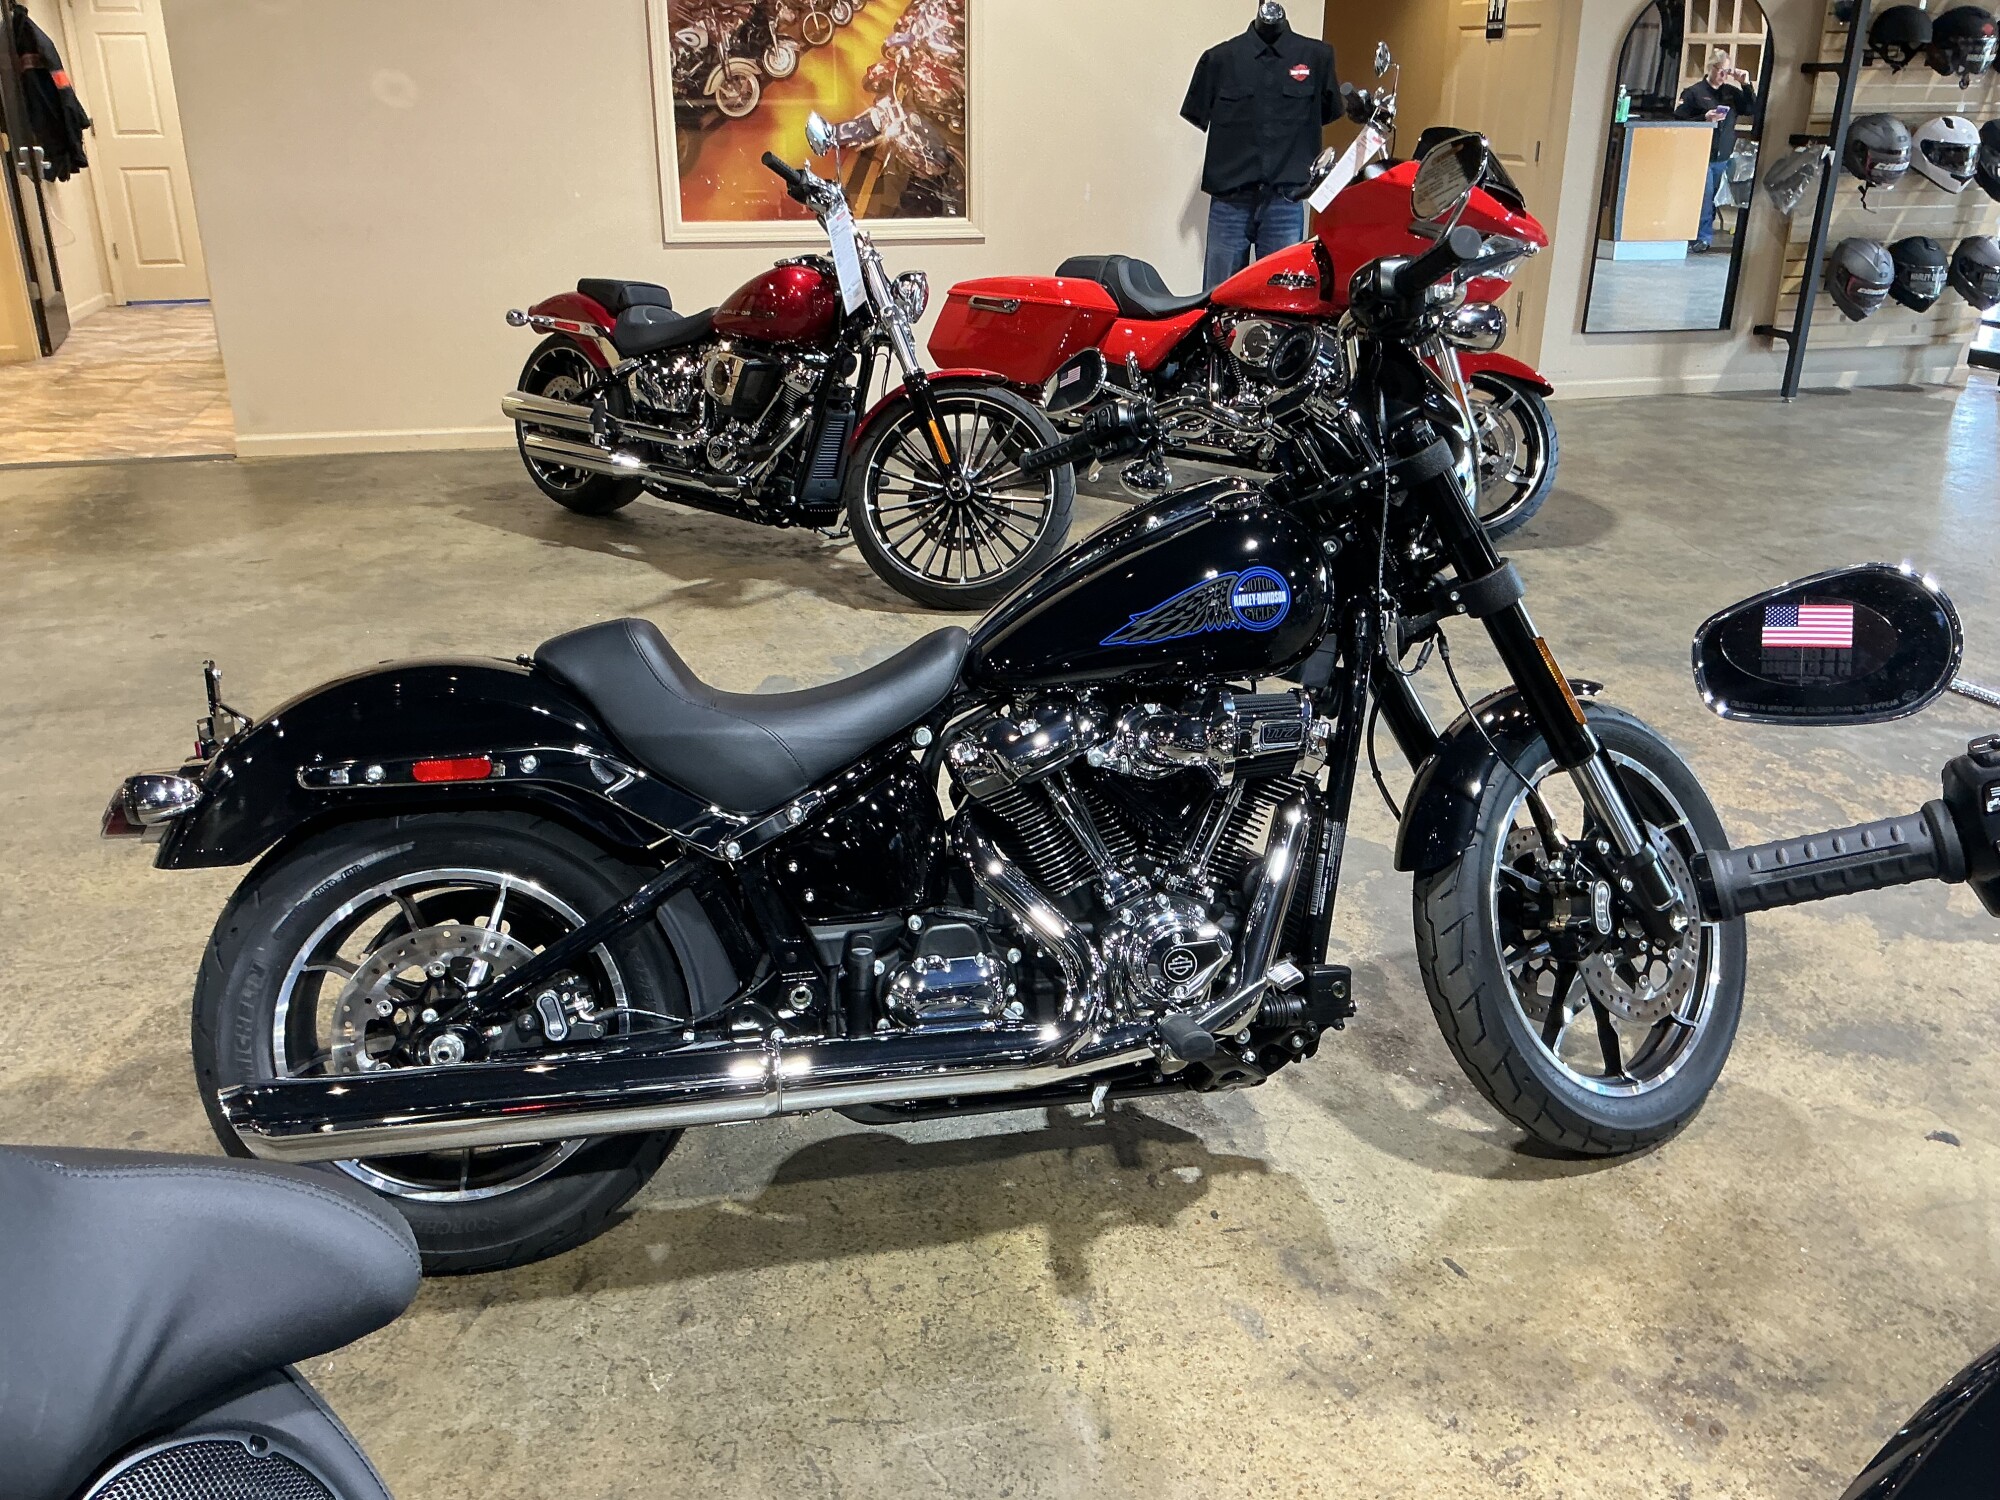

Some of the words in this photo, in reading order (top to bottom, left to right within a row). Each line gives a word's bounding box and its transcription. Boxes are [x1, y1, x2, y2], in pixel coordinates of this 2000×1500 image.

[1243, 576, 1275, 592] MOTOR
[1233, 590, 1287, 607] HARLEY-DAVIDSON
[1244, 605, 1277, 621] CYCLES
[1266, 726, 1301, 739] 117
